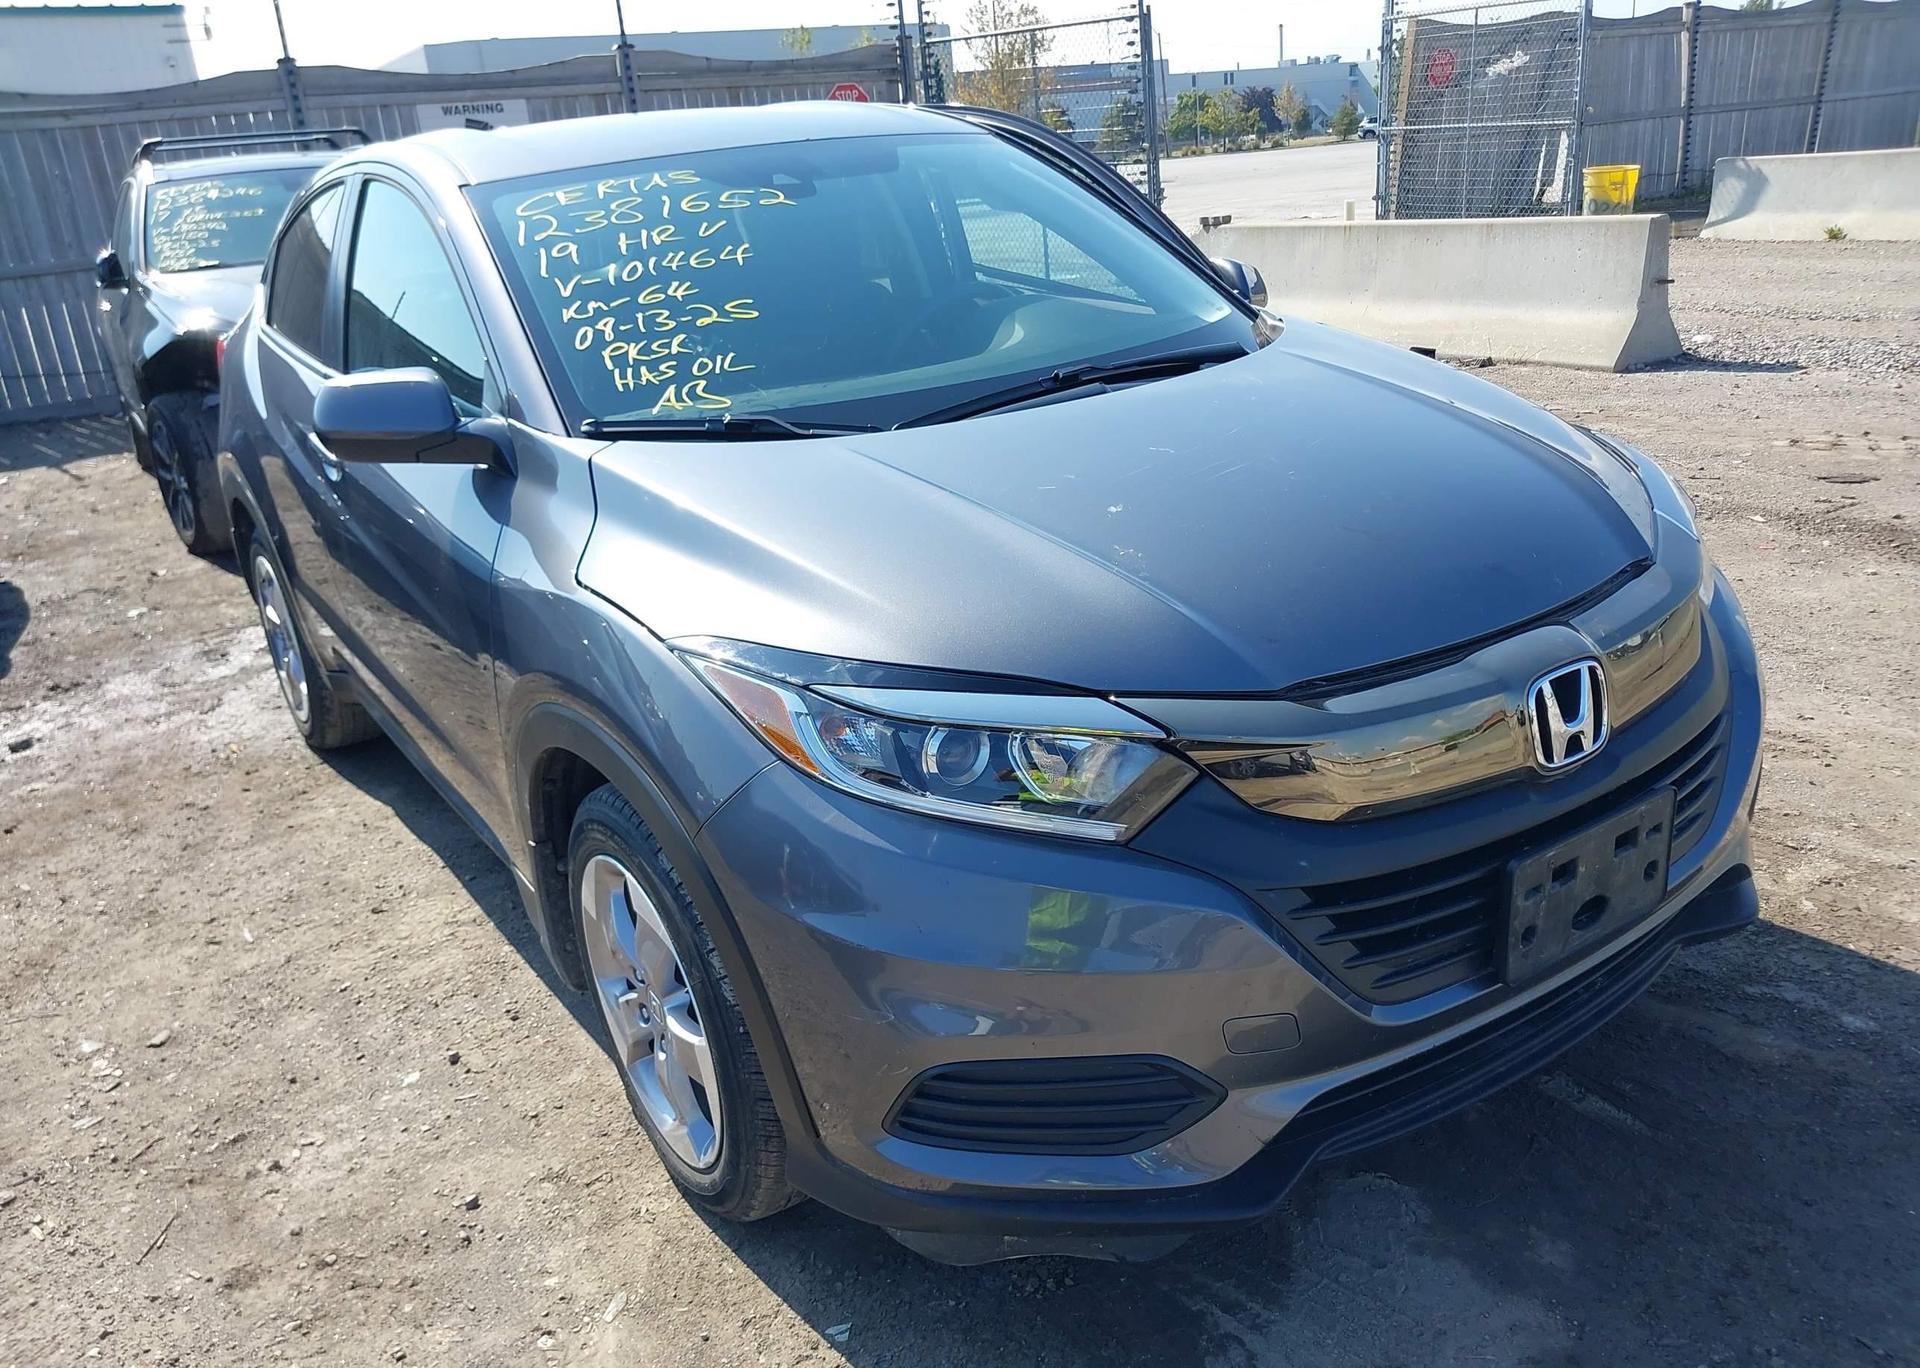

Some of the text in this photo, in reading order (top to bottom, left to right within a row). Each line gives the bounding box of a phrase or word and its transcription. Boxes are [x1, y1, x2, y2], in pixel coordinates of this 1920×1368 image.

[441, 102, 505, 117] WARNING
[835, 90, 859, 102] STOP
[515, 170, 702, 217] CERTAS
[533, 220, 728, 278] 19 HR V
[614, 352, 756, 392] HAS OIL
